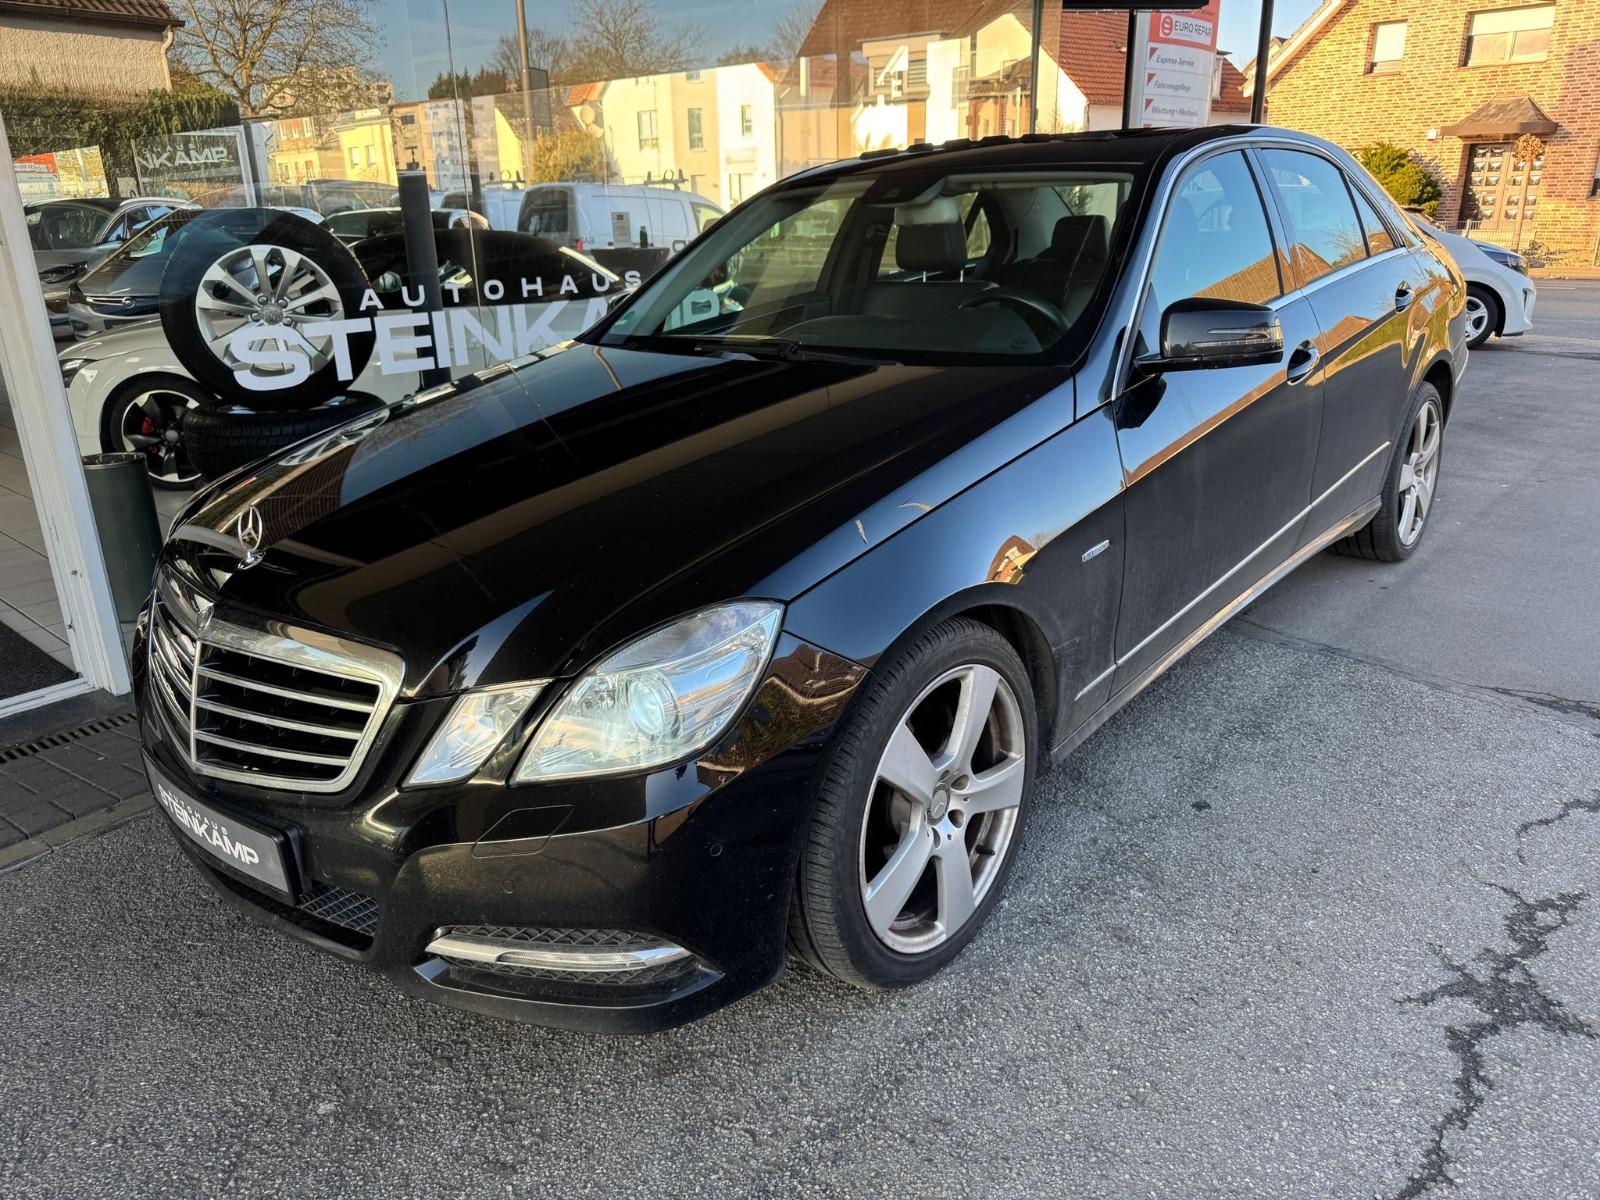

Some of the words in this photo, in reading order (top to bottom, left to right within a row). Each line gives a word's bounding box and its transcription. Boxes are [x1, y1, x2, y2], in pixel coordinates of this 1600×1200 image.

[1174, 20, 1193, 33] EURO
[359, 270, 642, 312] AUTOHAUS
[157, 783, 259, 865] STEINKAMP
[168, 791, 228, 836] AUTOHAUS
